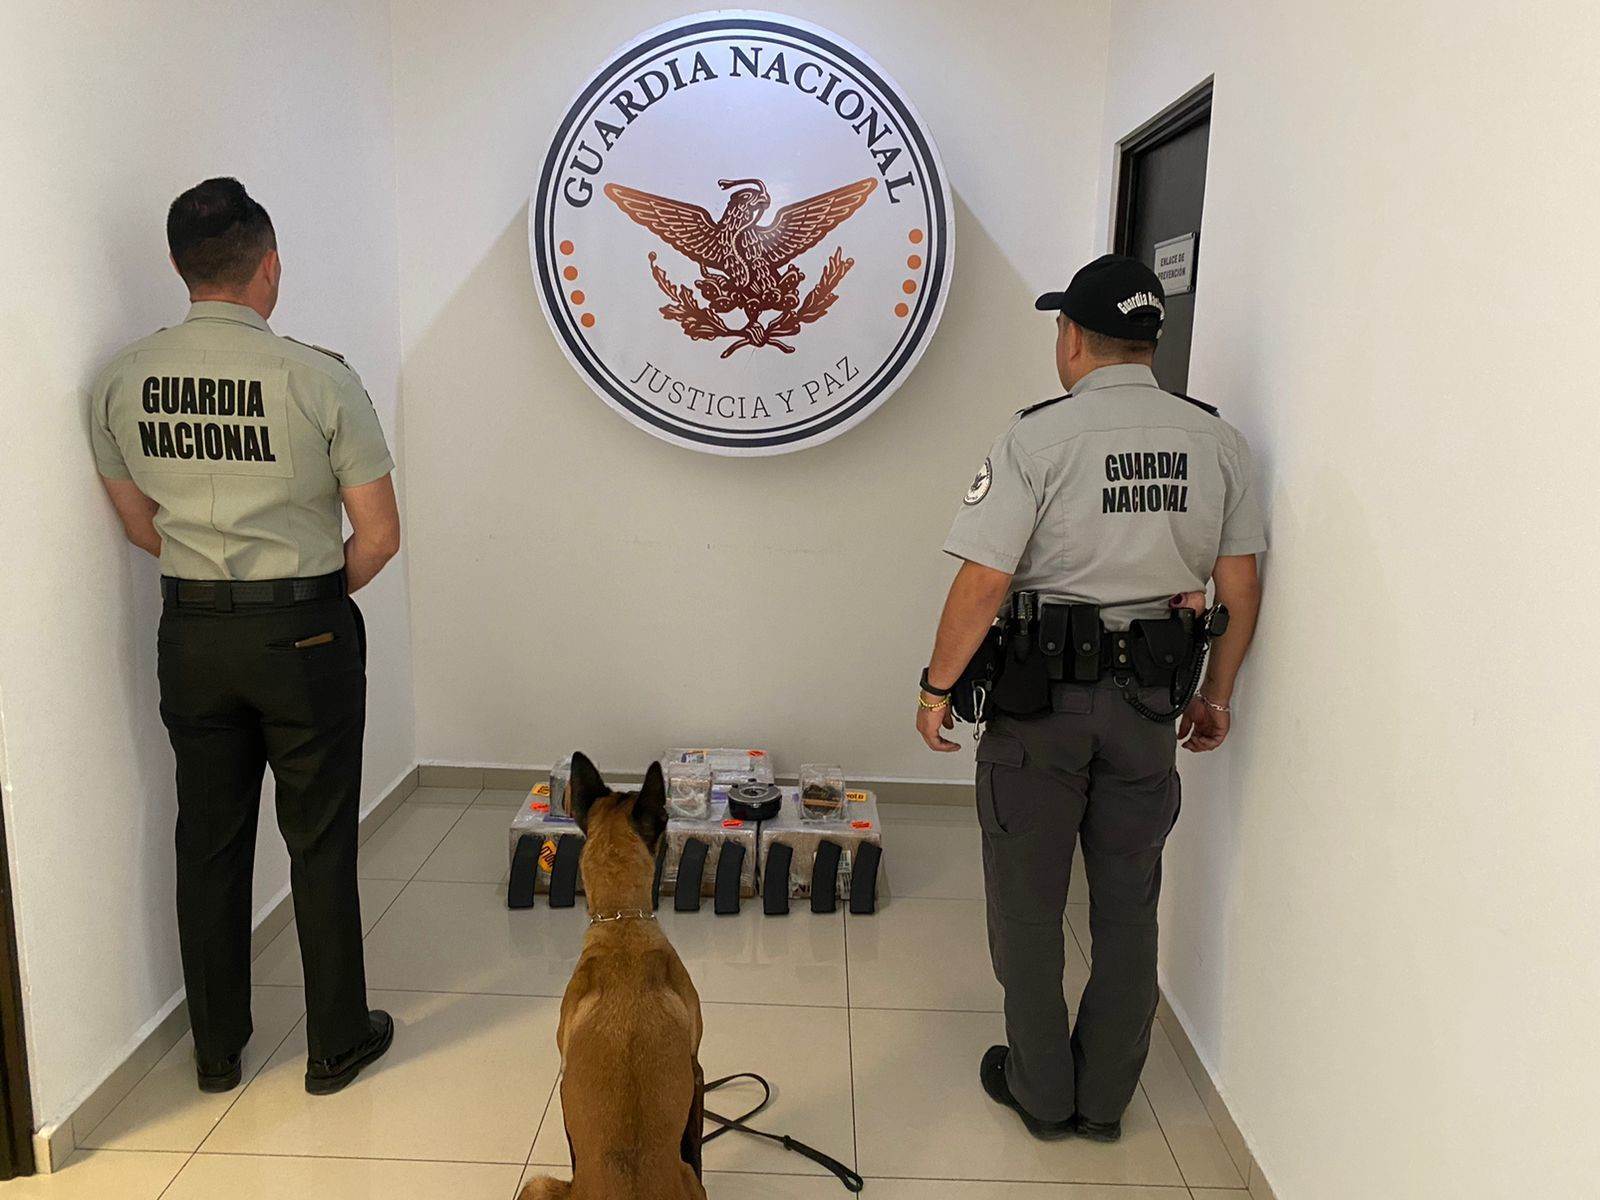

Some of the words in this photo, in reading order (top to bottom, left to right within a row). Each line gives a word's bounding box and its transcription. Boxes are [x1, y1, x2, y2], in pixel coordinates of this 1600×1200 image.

[563, 51, 718, 208] GUARDIA
[729, 46, 916, 205] NACIONAL
[1160, 255, 1177, 267] ENLACE
[1178, 252, 1185, 263] DE
[1117, 291, 1148, 315] Guardia
[142, 376, 265, 418] GUARDIA
[631, 361, 771, 419] JUSTICIA
[775, 391, 795, 414] Y
[802, 355, 859, 407] PAZ
[138, 421, 277, 462] NACIONAL
[1105, 452, 1188, 482] GUARDIA
